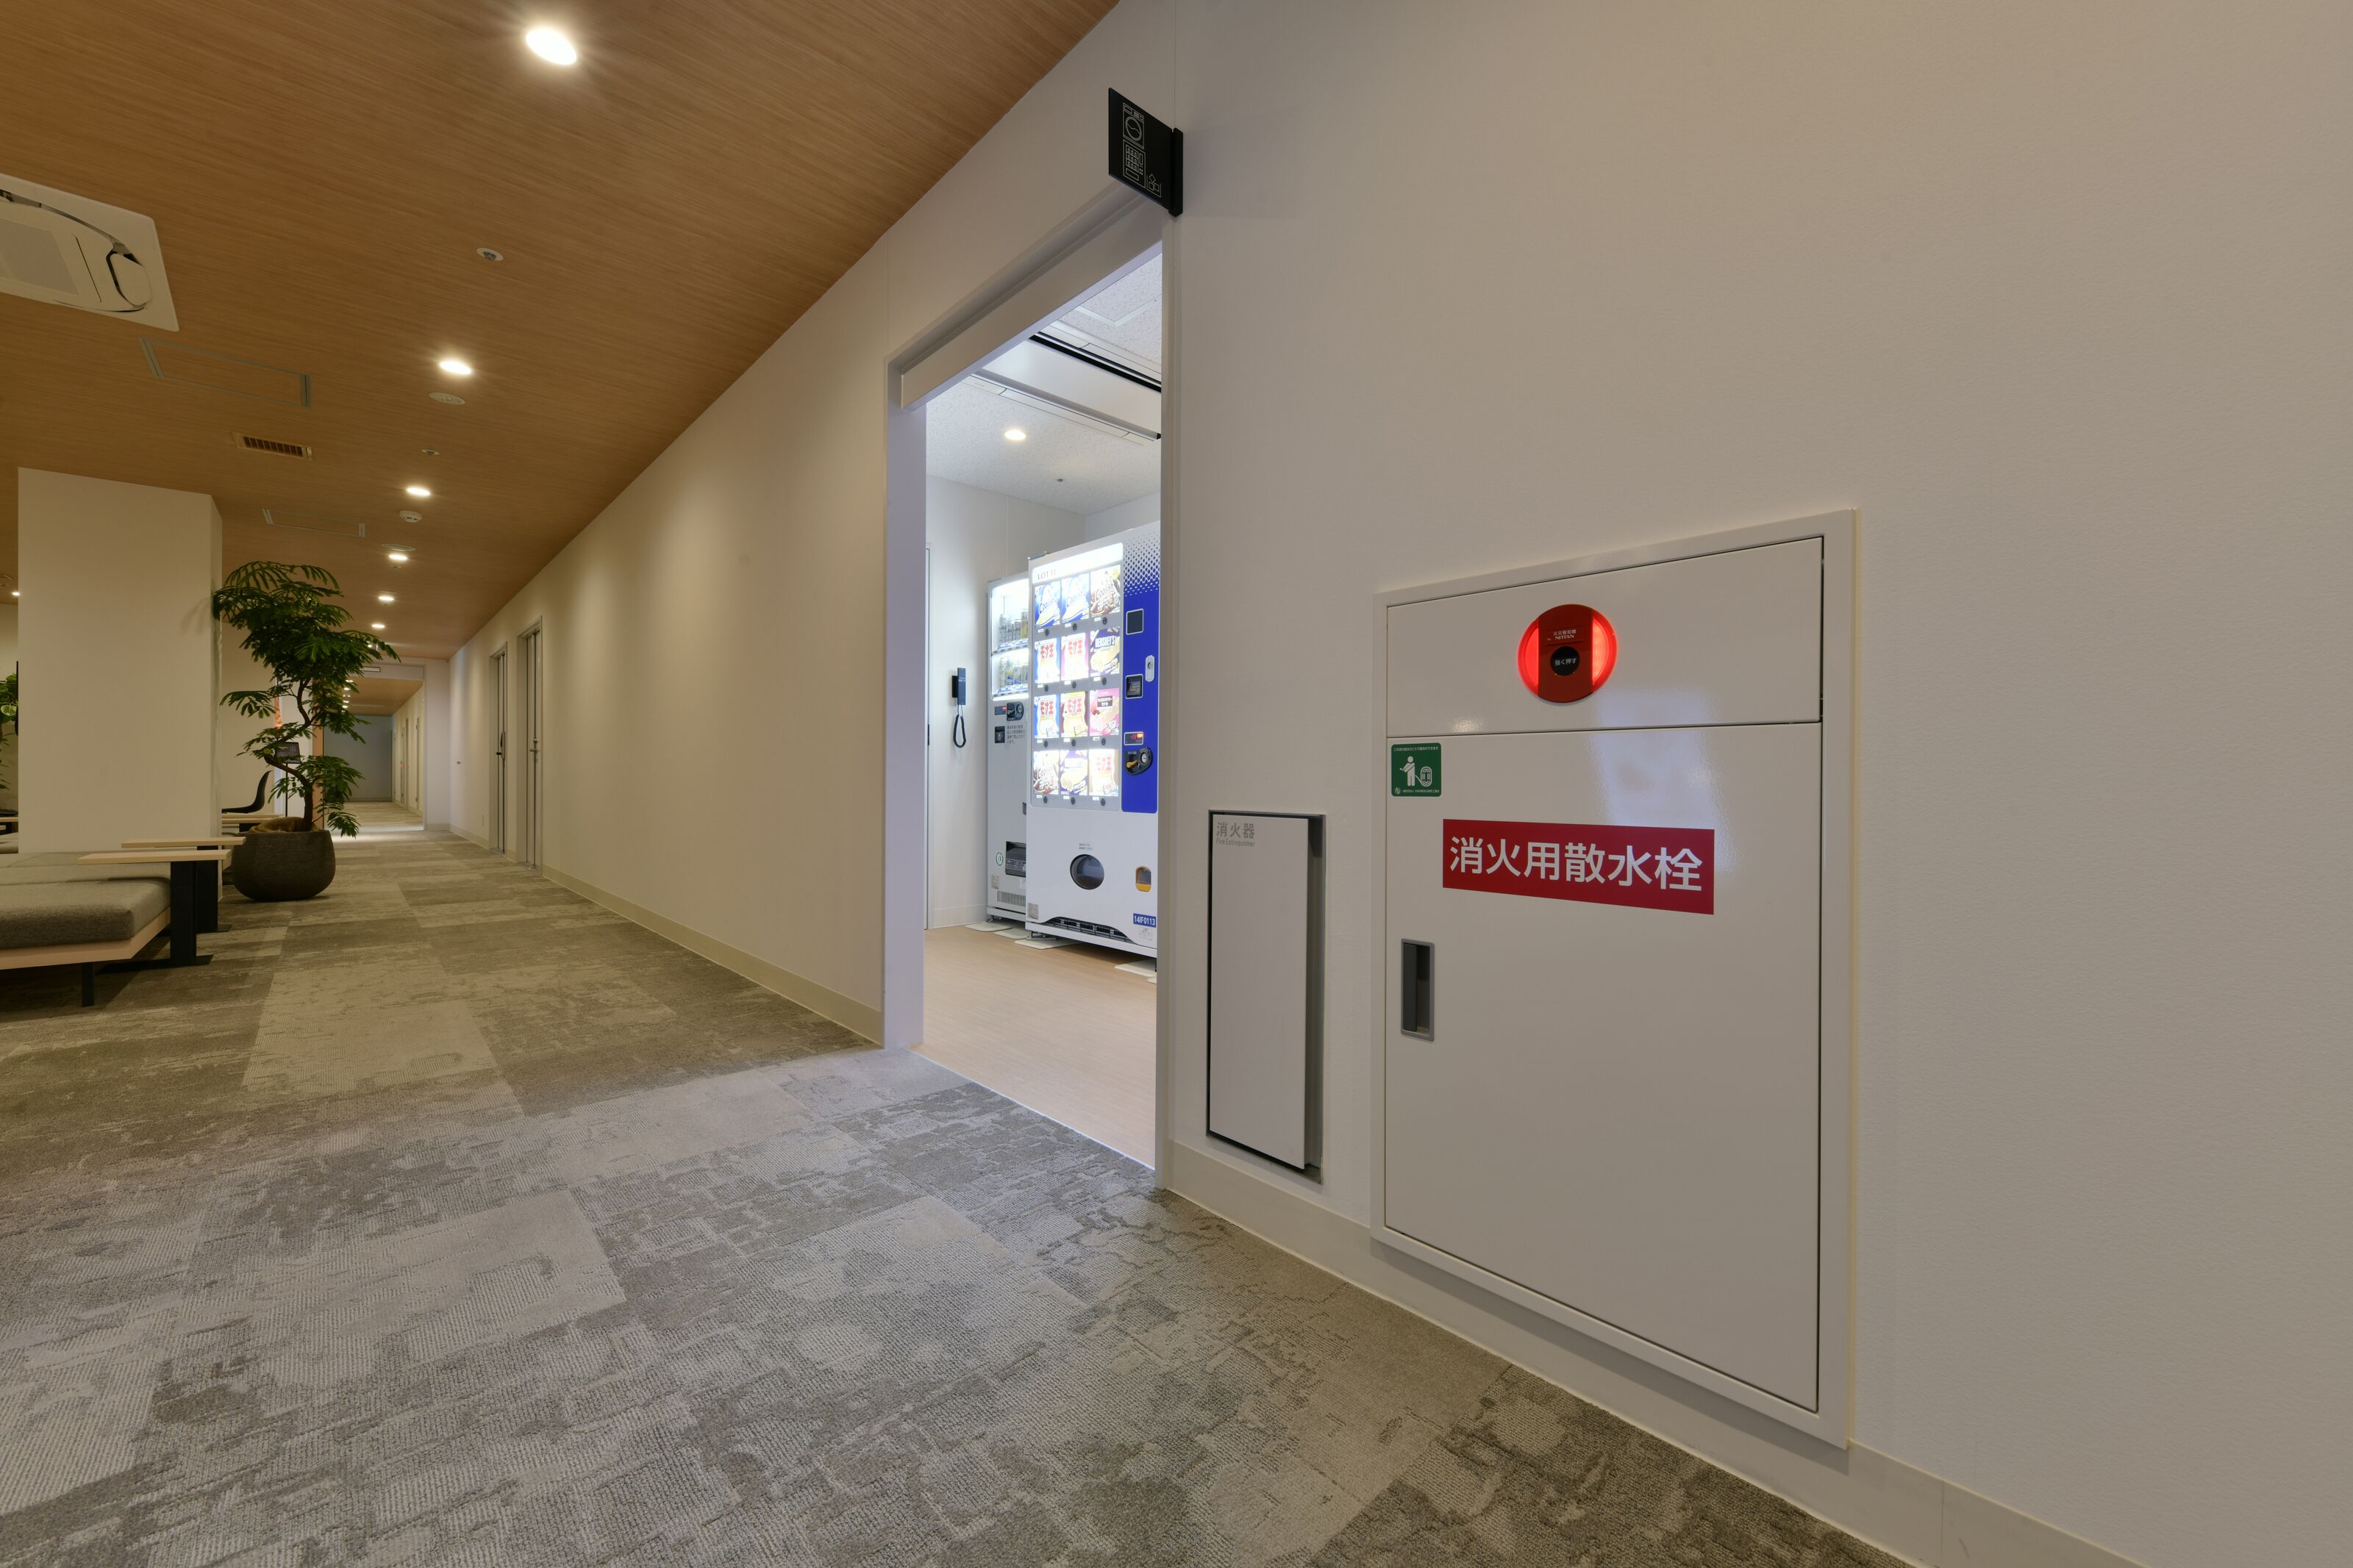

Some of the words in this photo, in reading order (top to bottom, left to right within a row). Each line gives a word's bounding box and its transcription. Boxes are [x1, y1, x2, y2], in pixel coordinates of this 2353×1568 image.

[1038, 569, 1057, 580] LOTTE
[1040, 642, 1054, 659] モナ王
[1068, 640, 1082, 655] モナ王
[1554, 658, 1577, 666] 強く押す
[1040, 699, 1054, 716] モナ王
[1068, 698, 1082, 713] モナ王
[1217, 821, 1254, 838] 消火器
[1450, 837, 1702, 891] 消火用散水栓
